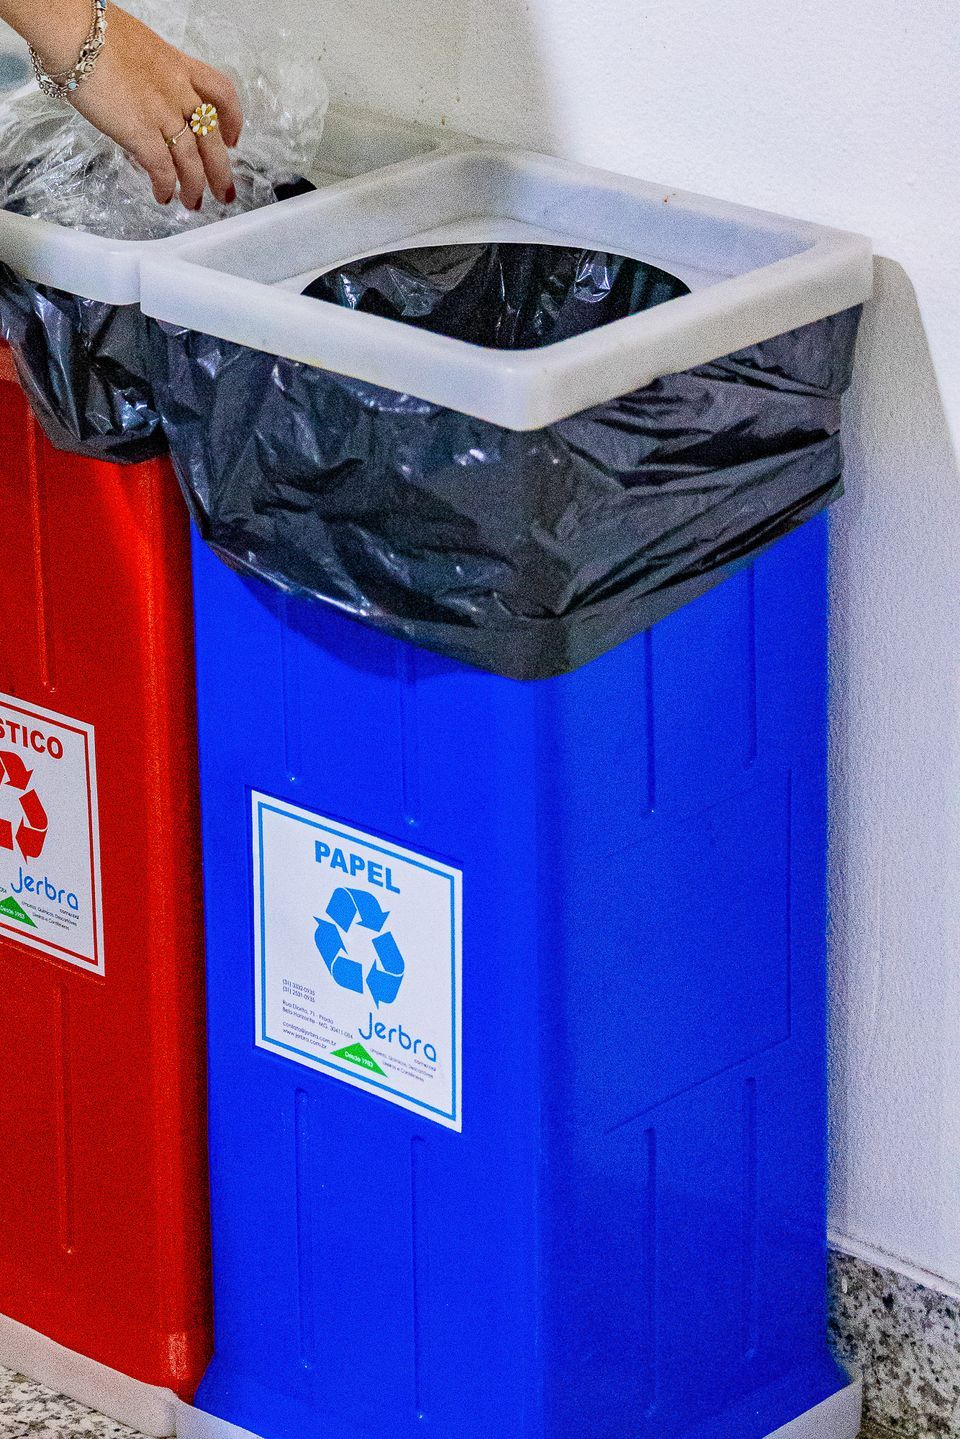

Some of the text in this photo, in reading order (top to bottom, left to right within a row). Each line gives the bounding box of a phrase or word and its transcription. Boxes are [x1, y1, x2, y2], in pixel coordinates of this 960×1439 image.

[10, 866, 79, 910] Jerbra
[314, 840, 401, 894] PAPEL
[359, 1012, 436, 1062] Jerbra
